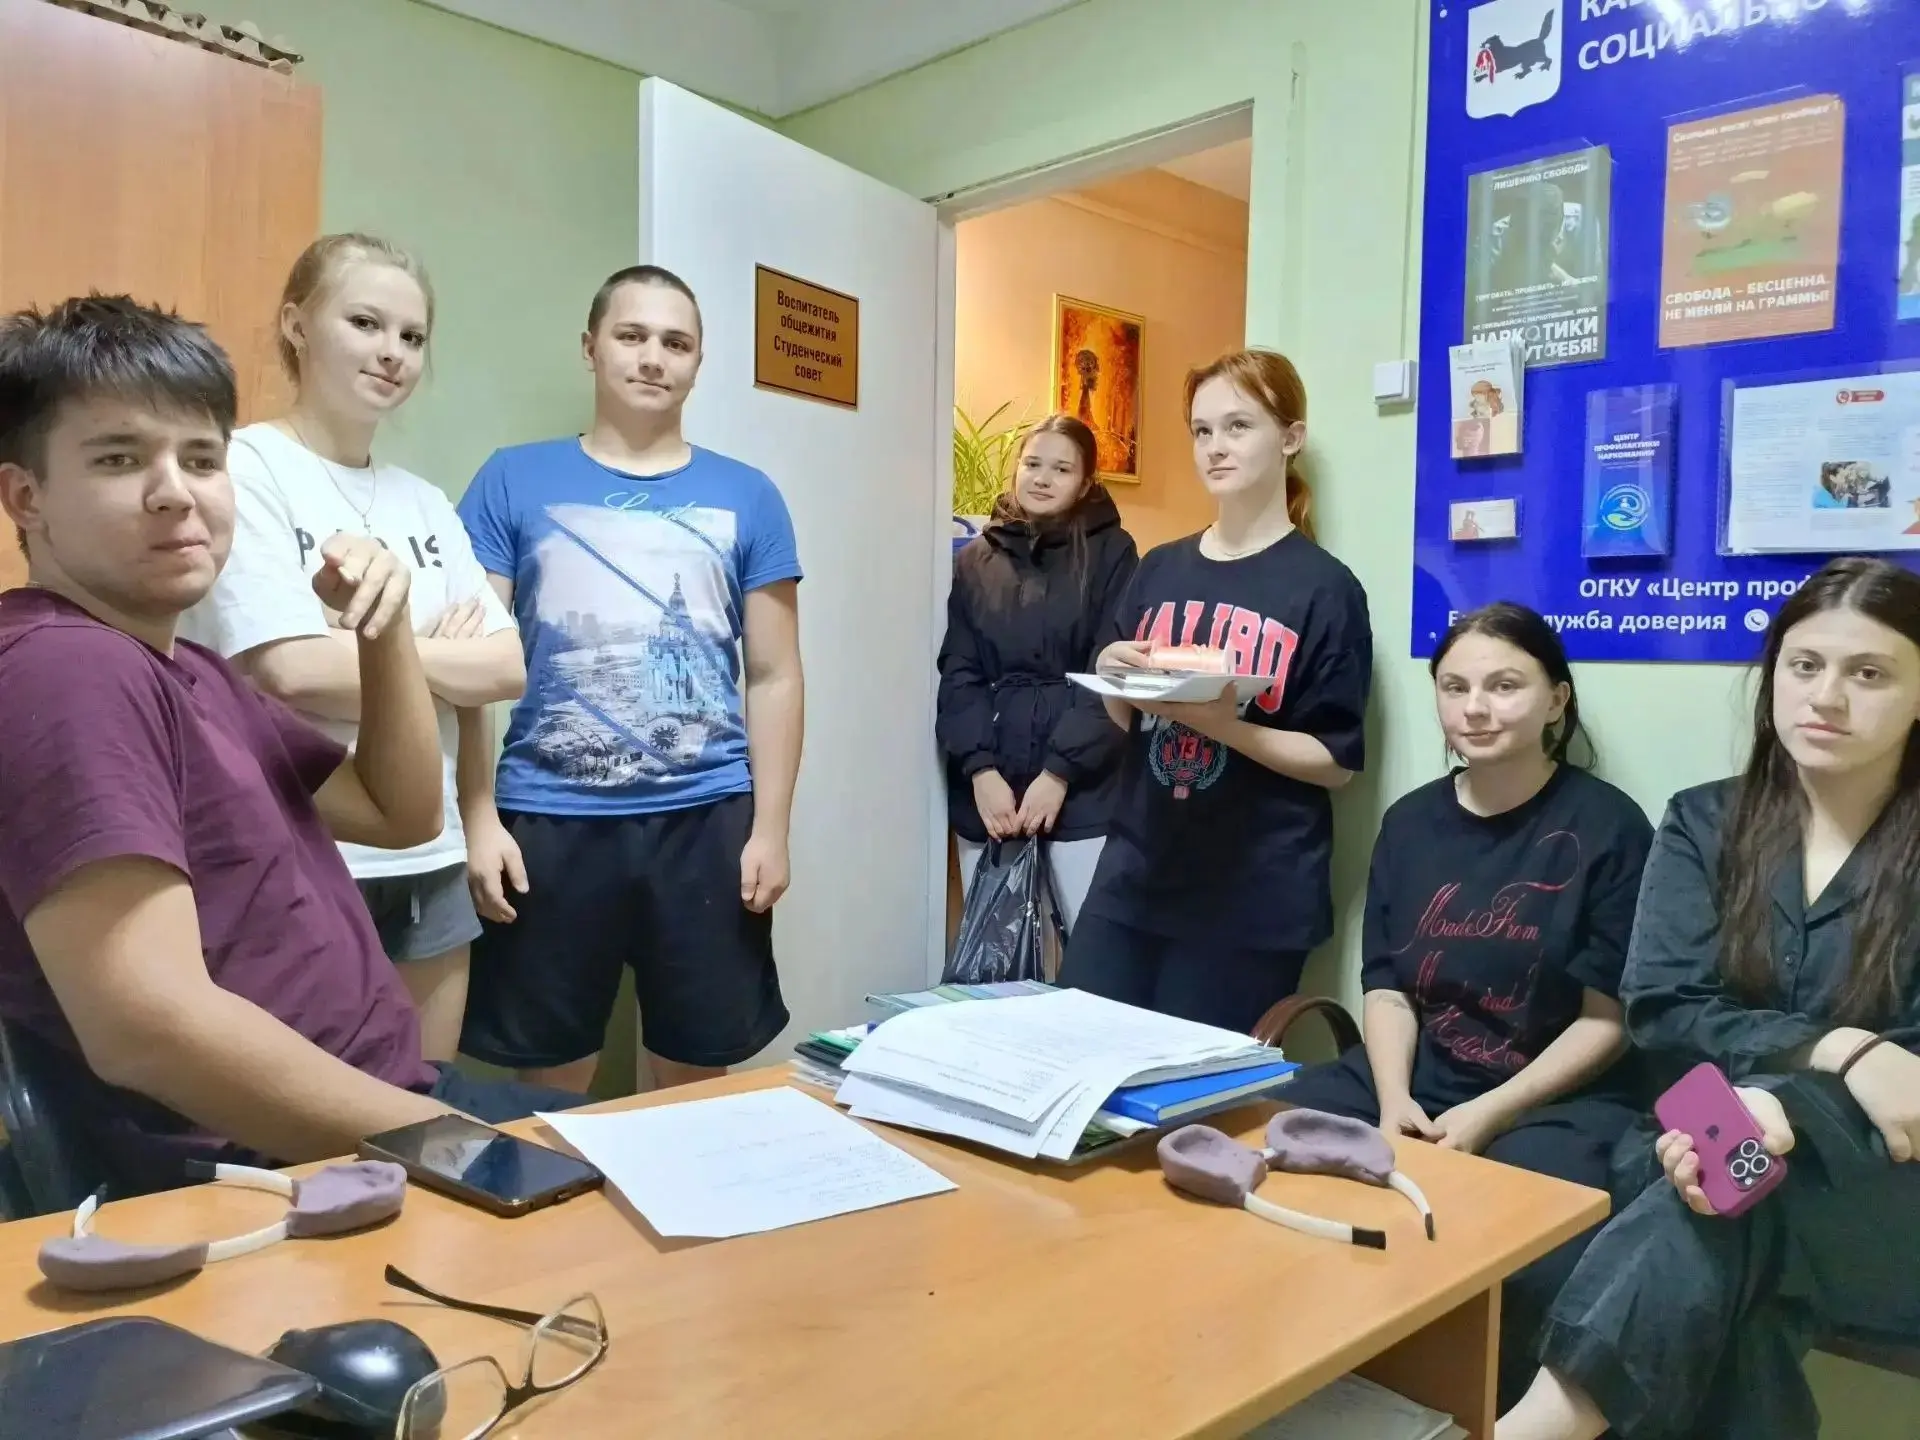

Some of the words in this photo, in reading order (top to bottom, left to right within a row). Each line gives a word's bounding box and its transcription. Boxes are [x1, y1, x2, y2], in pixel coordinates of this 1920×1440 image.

[777, 289, 840, 324] Воспитатель
[1665, 286, 1731, 305] СВОБОДА
[1665, 309, 1683, 321] НЕ
[1684, 301, 1733, 318] МЕНЯЙ
[1736, 299, 1757, 312] НА
[780, 314, 837, 342] общежития
[774, 335, 843, 368] Студенческий
[794, 364, 823, 382] совет
[1594, 440, 1660, 452] ПРОФИЛАКТИКИ
[1613, 432, 1640, 442] ЦЕНТР
[1597, 449, 1655, 460] НАРКОМАНИИ
[296, 527, 443, 572] PIS
[1579, 578, 1640, 598] ОГКУ
[1647, 577, 1739, 600] «Центр
[1618, 612, 1726, 635] доверия
